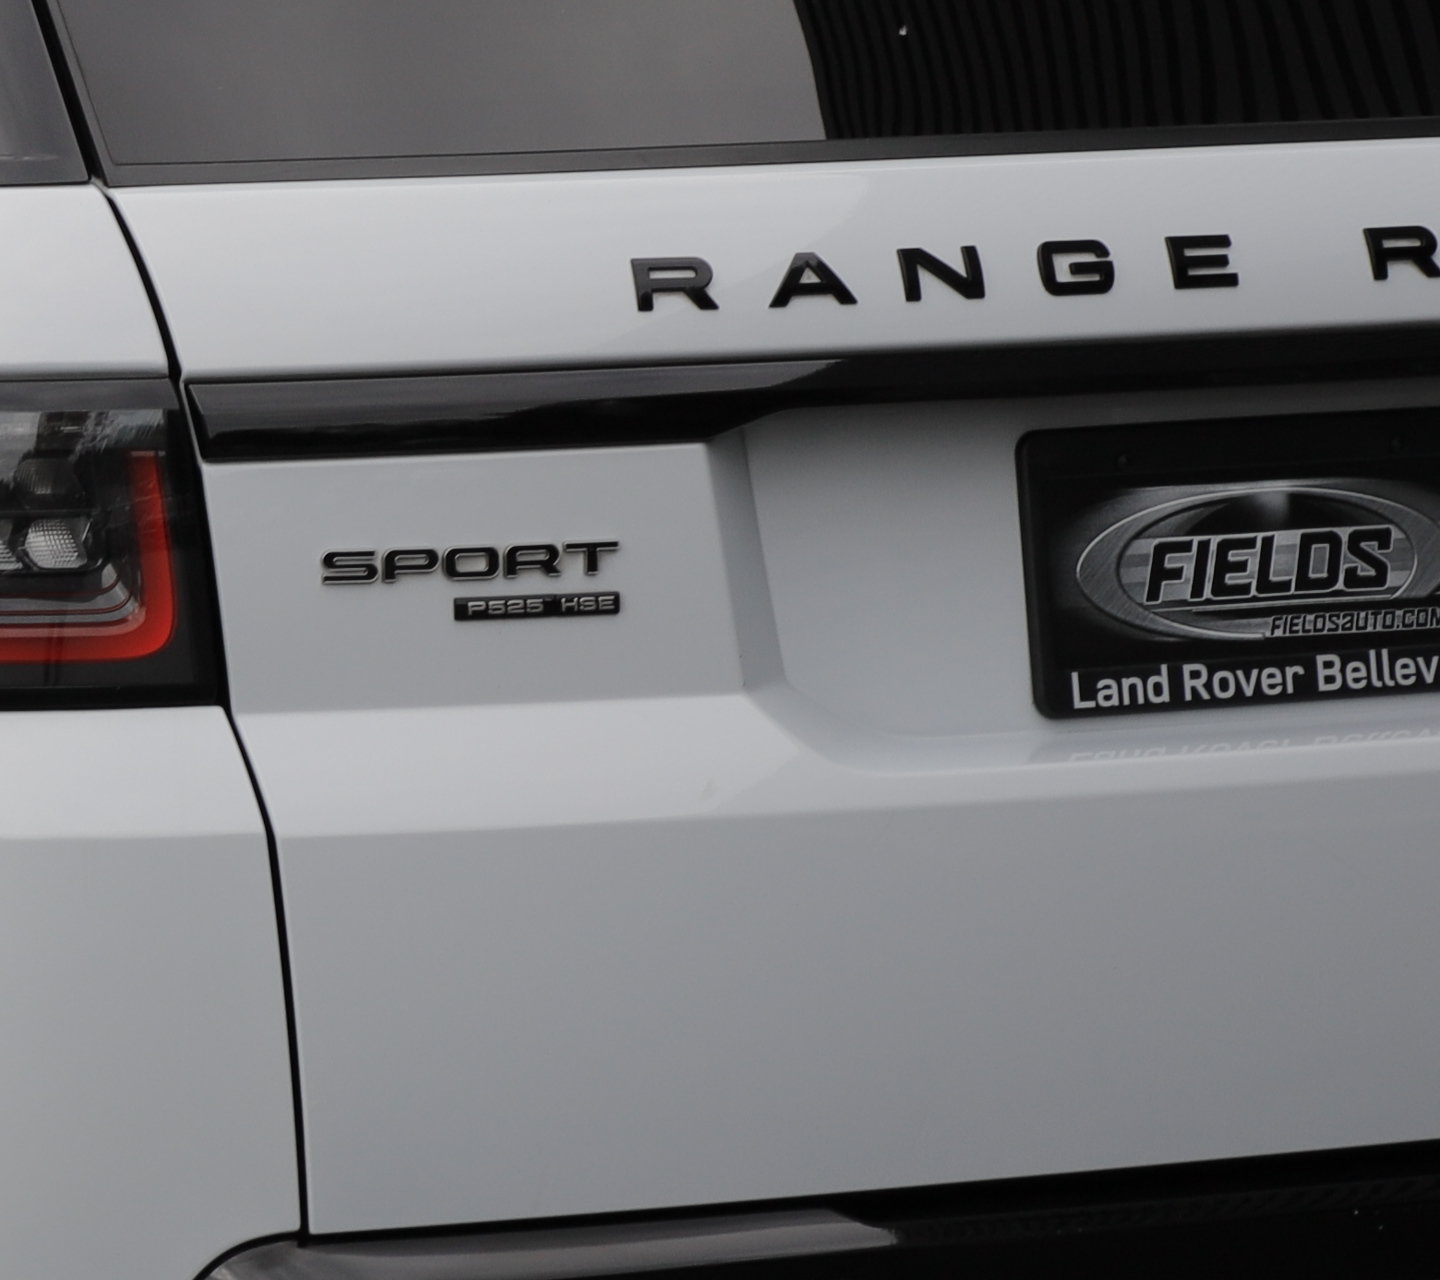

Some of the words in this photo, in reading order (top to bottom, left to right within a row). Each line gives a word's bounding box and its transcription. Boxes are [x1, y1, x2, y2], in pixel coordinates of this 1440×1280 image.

[628, 233, 1241, 314] RANGE
[322, 541, 620, 584] SPORT
[1144, 524, 1395, 605] FIELDS
[467, 598, 544, 616] P525
[560, 595, 616, 612] HSE
[1071, 664, 1171, 710] Land
[1183, 661, 1304, 702] Rover
